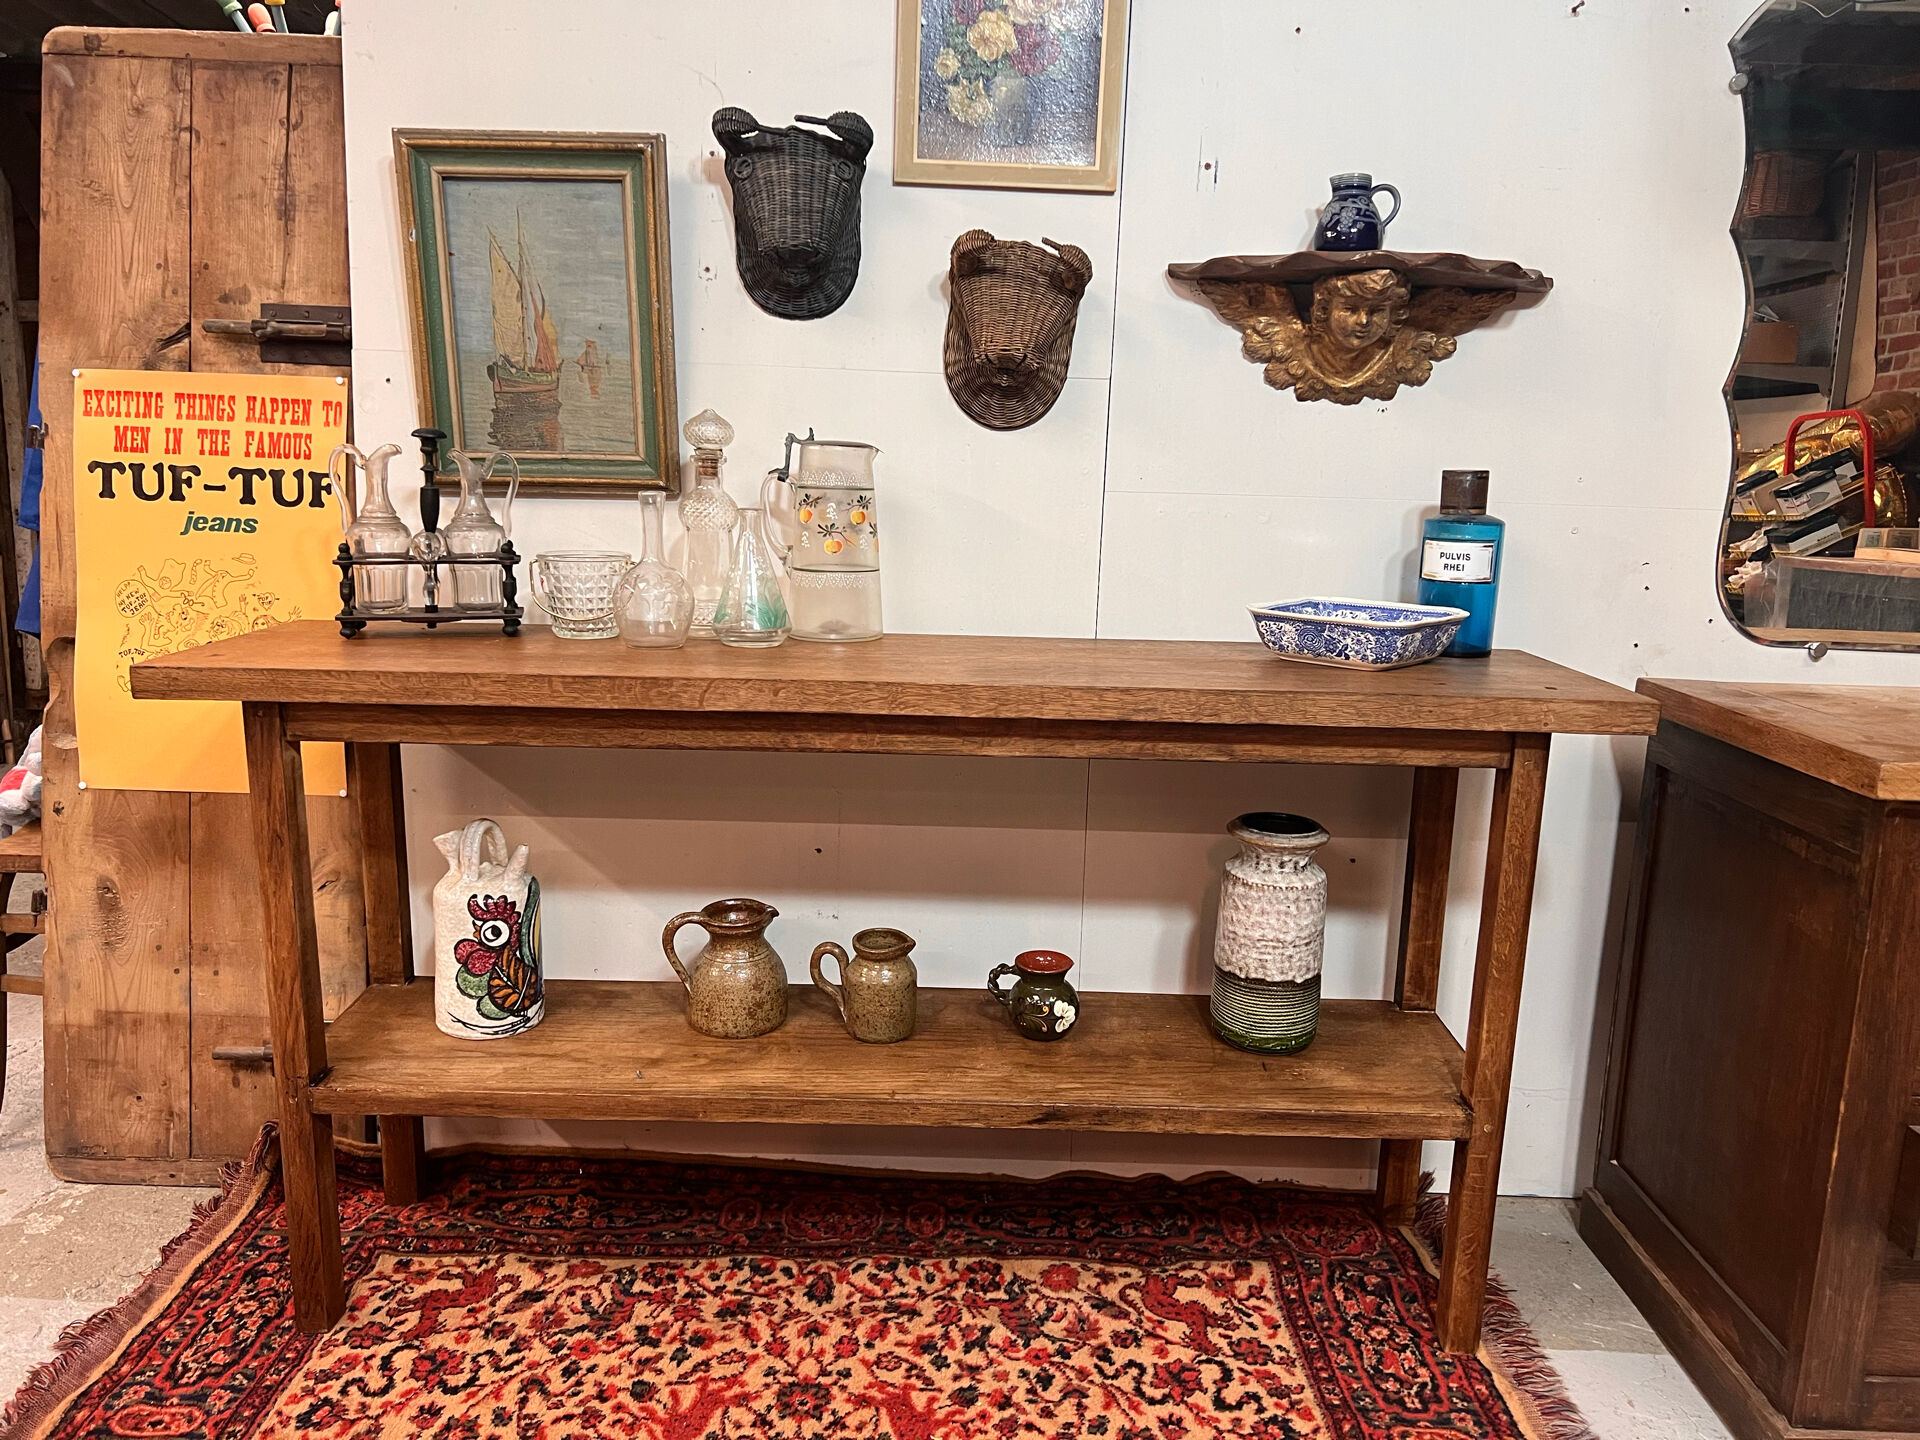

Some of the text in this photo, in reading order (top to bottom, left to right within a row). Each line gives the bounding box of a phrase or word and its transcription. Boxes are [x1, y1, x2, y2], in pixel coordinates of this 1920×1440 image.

[82, 389, 342, 428] EXCITING THINGS HAPPEN TO
[113, 425, 313, 460] MEN IN THE FAMOUS
[87, 460, 341, 508] TUF-TUF
[180, 511, 259, 535] jeans
[1439, 551, 1471, 561] PULVIS
[1443, 563, 1465, 572] RHEI
